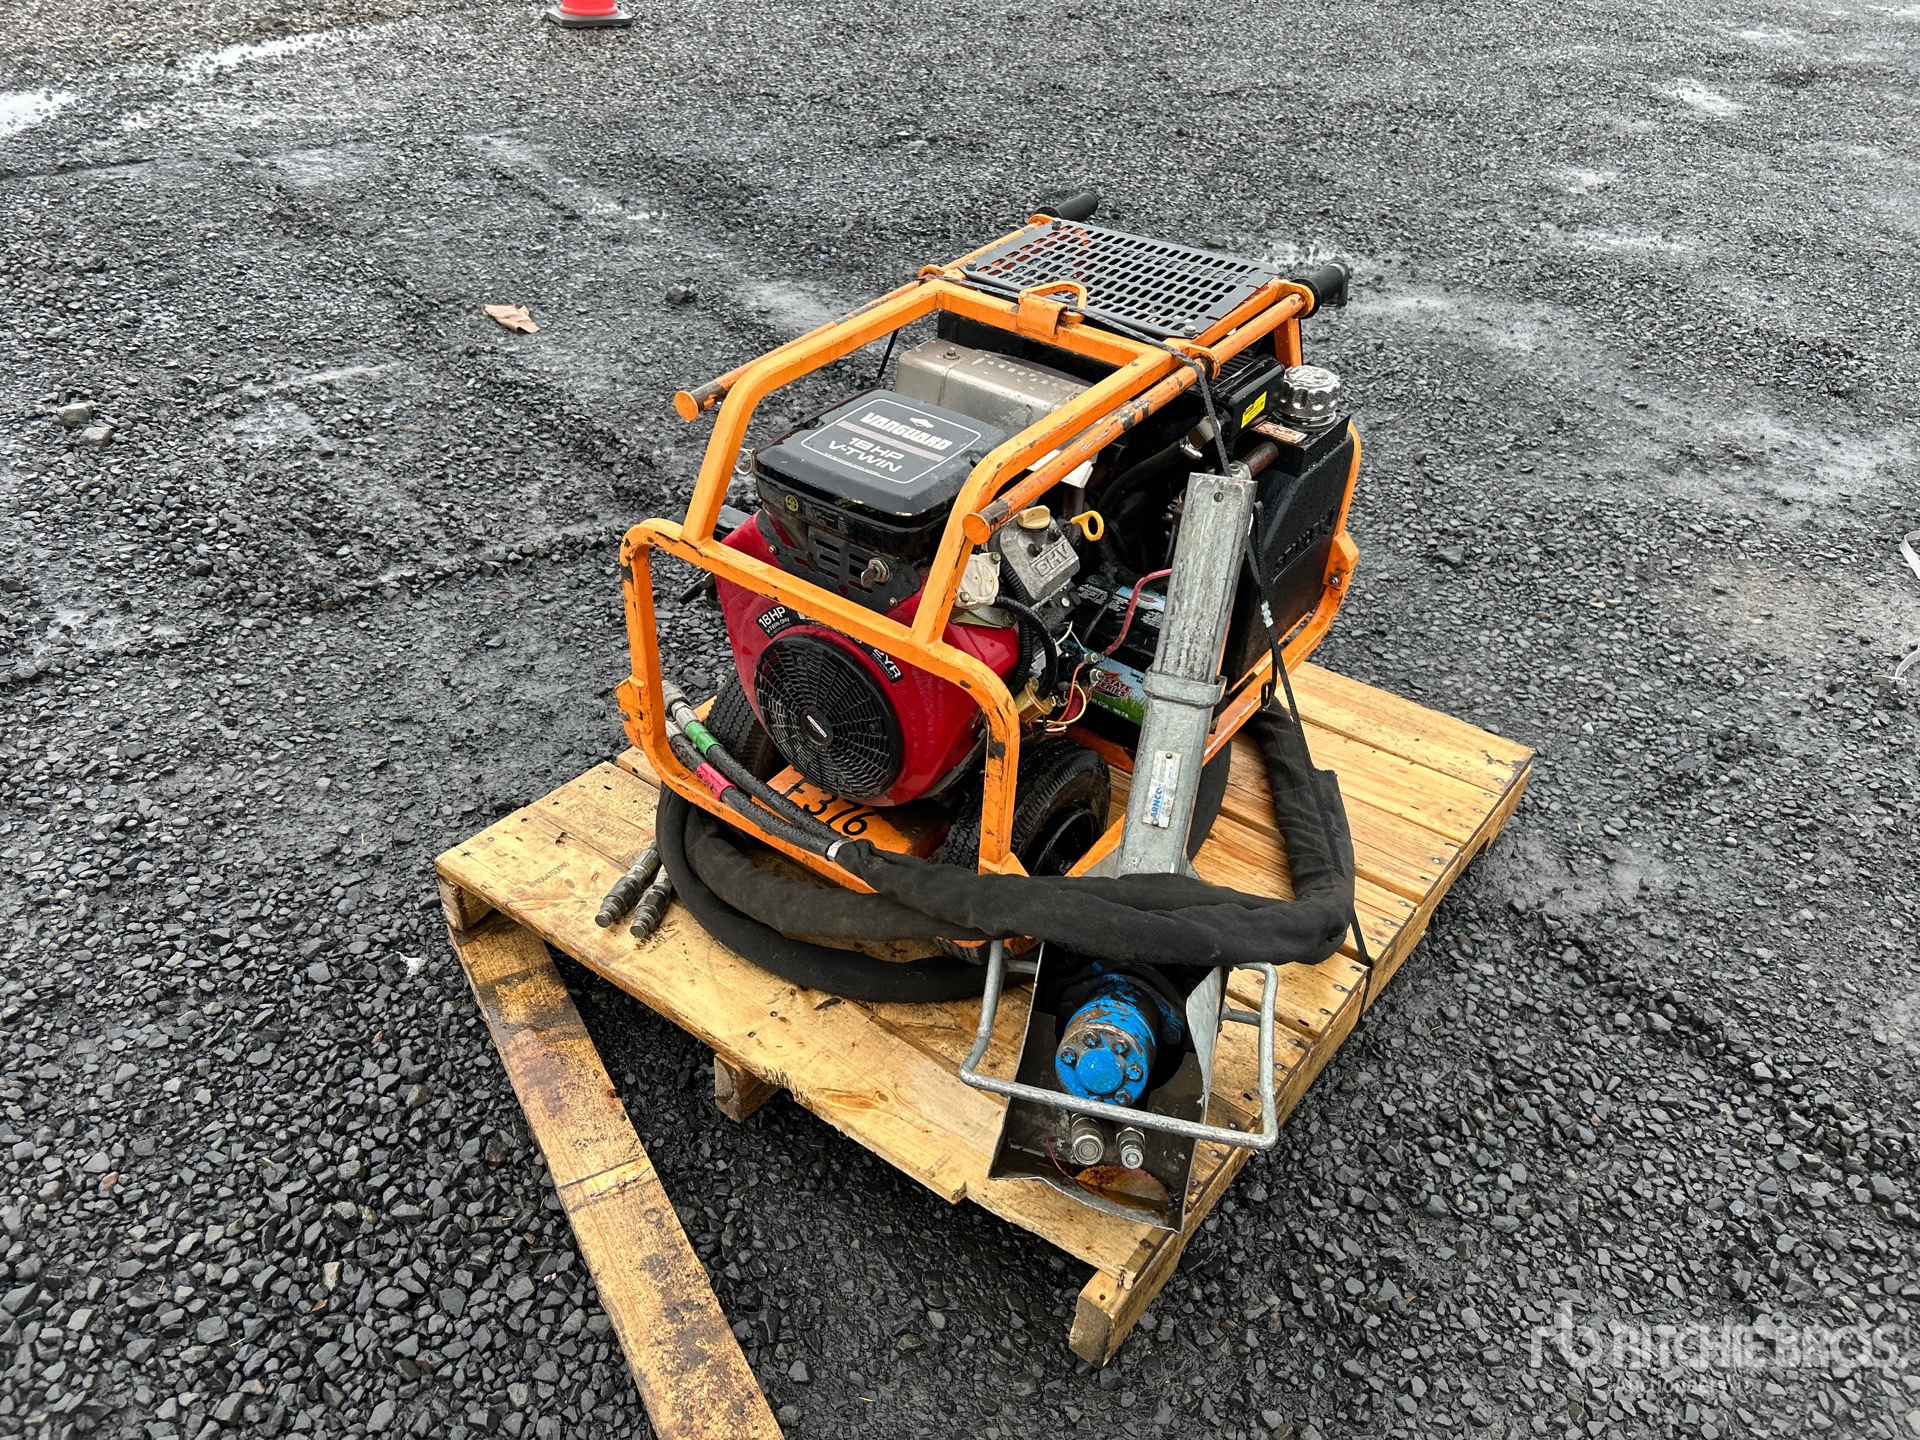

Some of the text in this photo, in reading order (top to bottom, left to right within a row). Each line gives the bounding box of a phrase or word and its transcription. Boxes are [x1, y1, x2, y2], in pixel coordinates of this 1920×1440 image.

[860, 412, 953, 450] VANGUARD
[828, 440, 903, 473] V-TWIN
[1033, 542, 1069, 577] OHV
